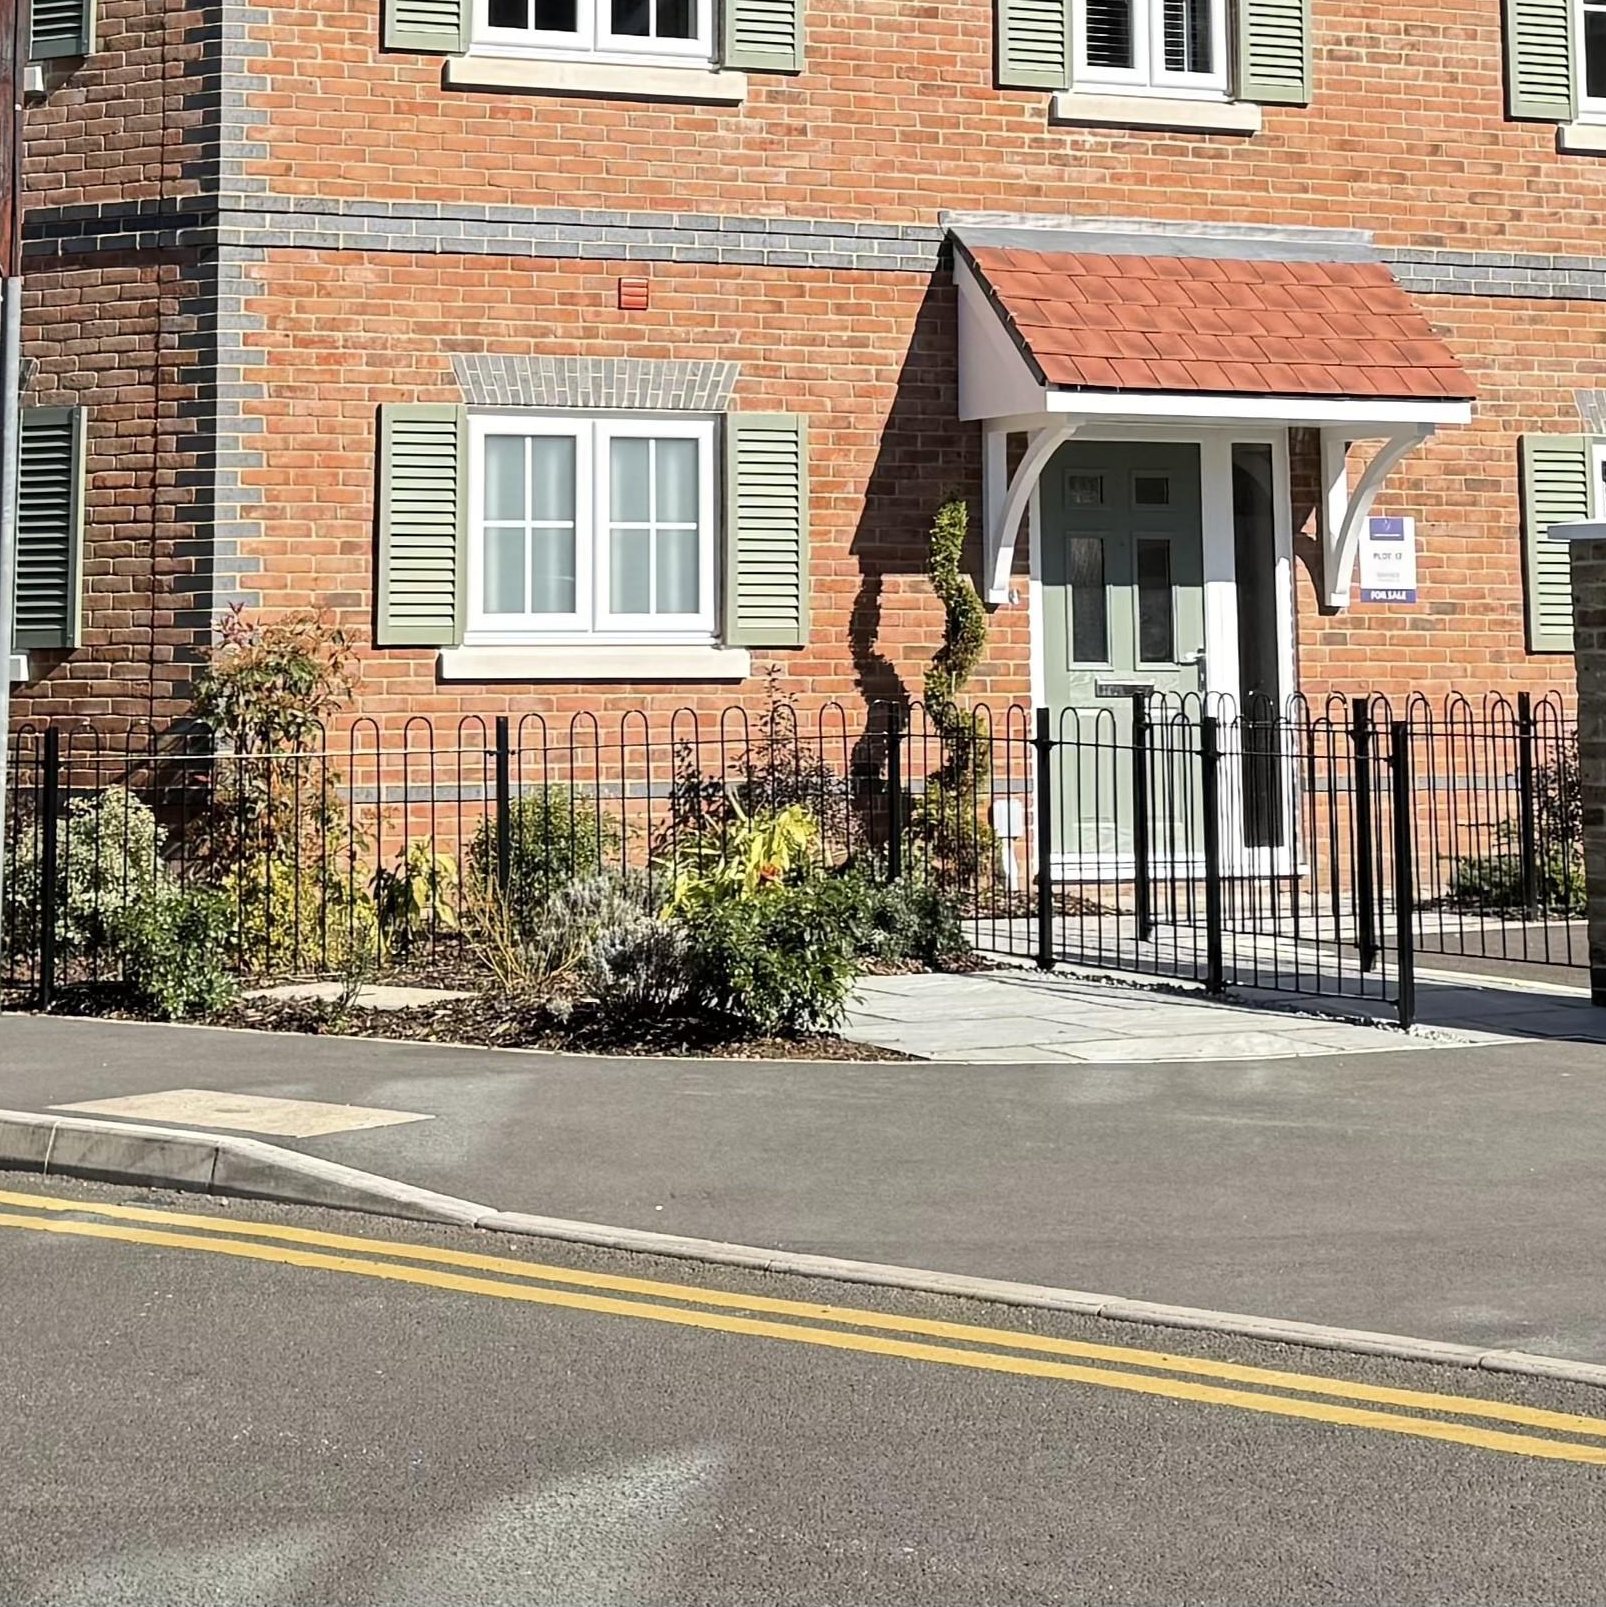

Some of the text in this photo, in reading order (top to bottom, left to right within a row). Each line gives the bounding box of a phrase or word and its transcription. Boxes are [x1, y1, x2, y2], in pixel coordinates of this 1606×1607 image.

[1373, 552, 1391, 560] PLOT
[1370, 590, 1407, 600] FOR SALE
